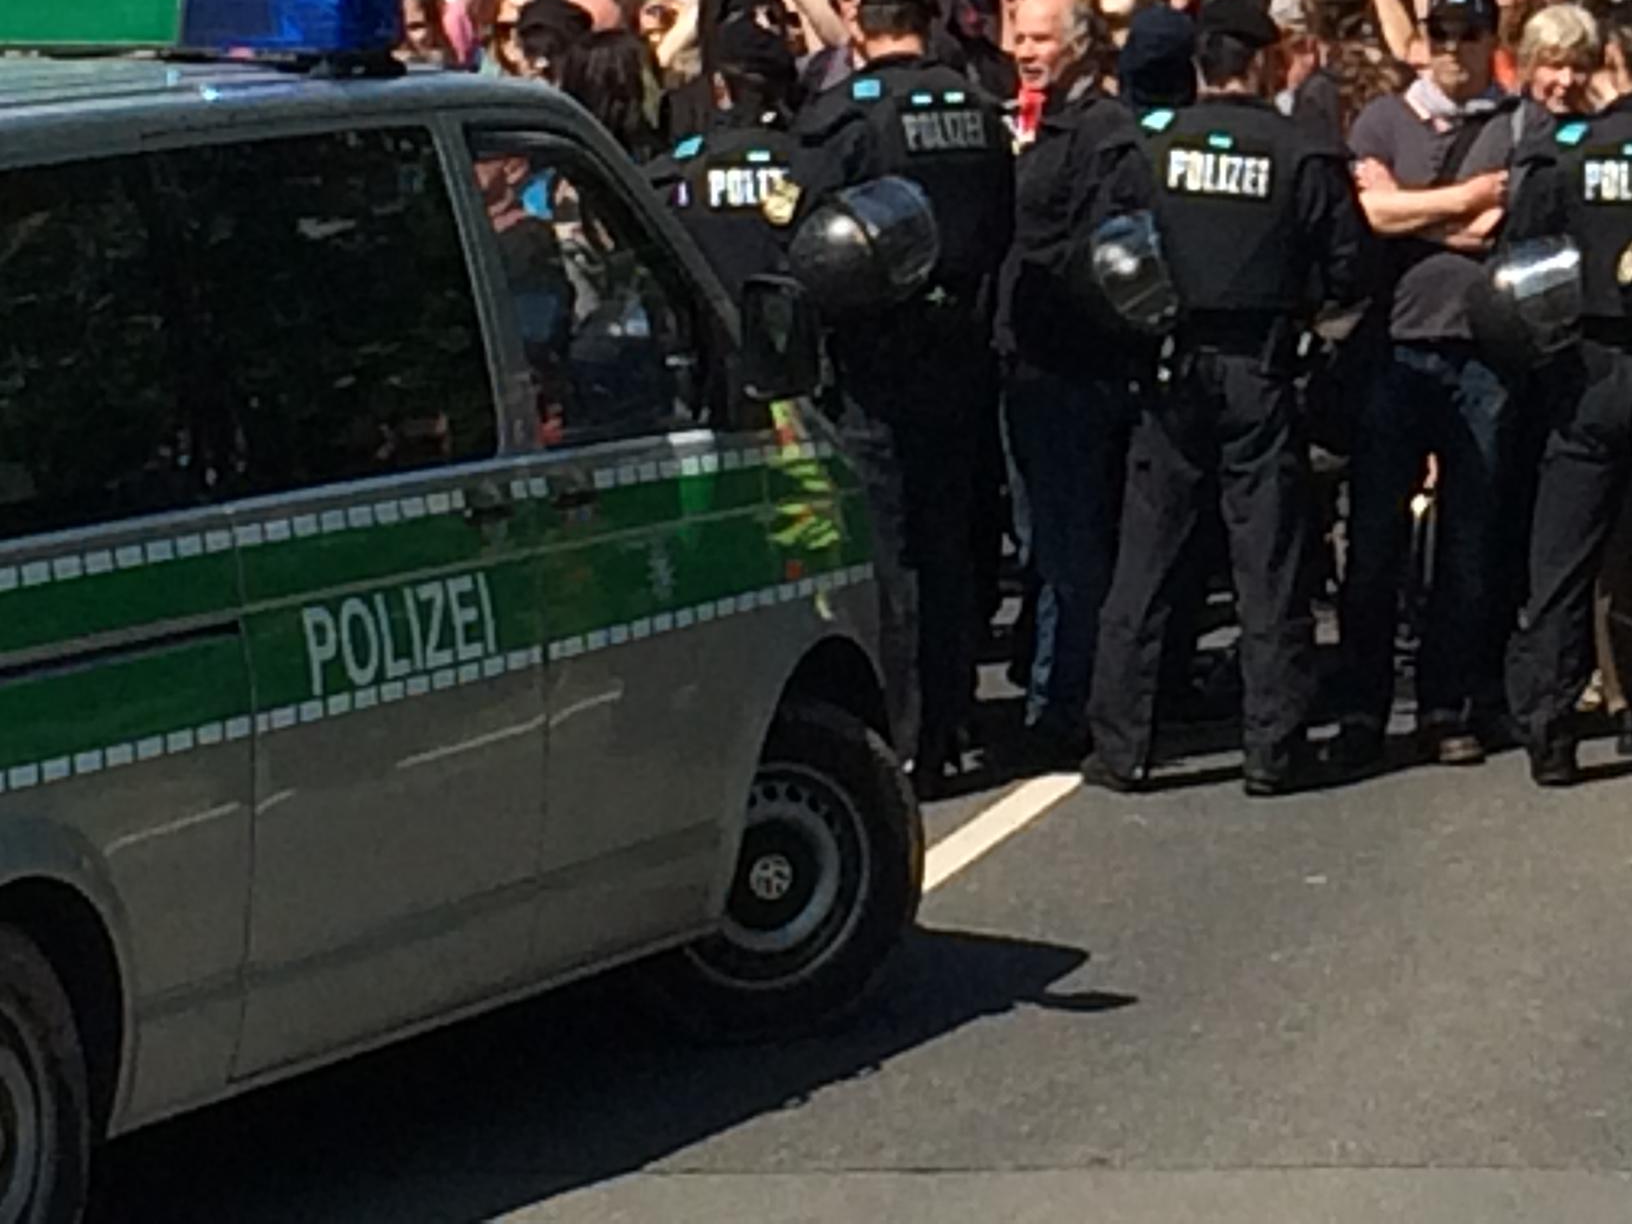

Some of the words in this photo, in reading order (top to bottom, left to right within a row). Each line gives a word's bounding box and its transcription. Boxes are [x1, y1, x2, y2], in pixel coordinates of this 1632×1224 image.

[902, 109, 987, 151] POLIZEI
[1168, 149, 1270, 197] POLIZEI
[302, 572, 496, 696] POLIZEI
